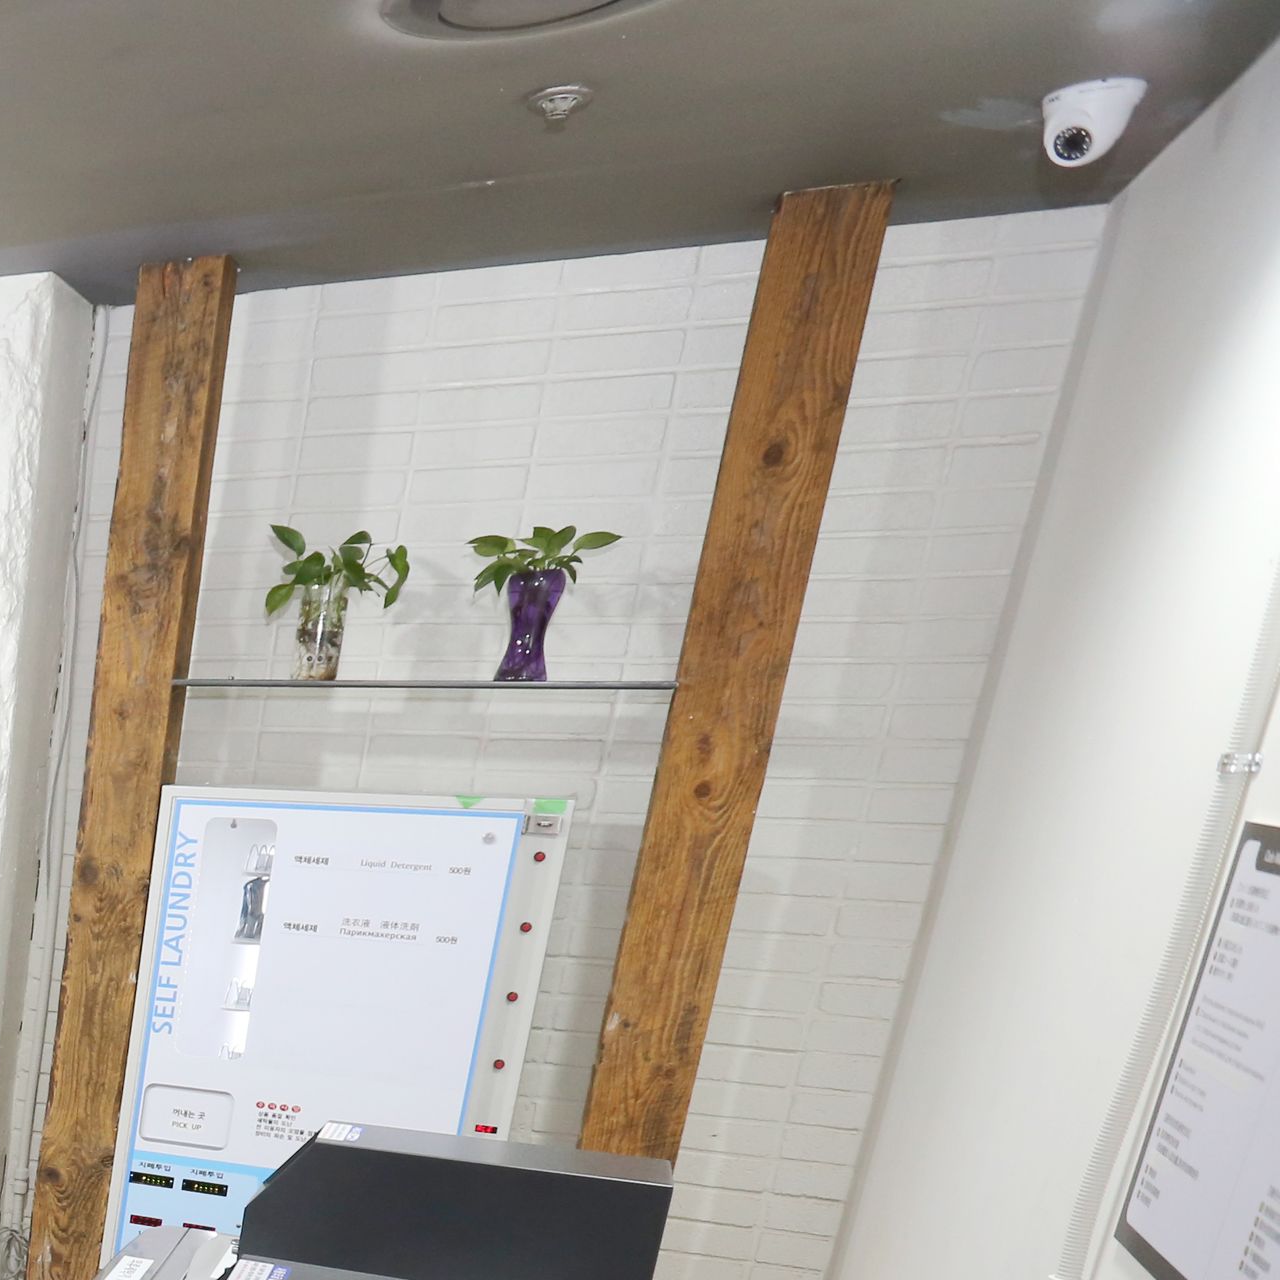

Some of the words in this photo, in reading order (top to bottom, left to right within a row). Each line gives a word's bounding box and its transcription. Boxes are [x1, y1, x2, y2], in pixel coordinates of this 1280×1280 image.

[360, 859, 386, 870] Liquid
[390, 860, 433, 872] Detergent
[161, 831, 198, 967] LAUNDRY
[152, 975, 178, 1035] SELF
[172, 1120, 188, 1129] PICK
